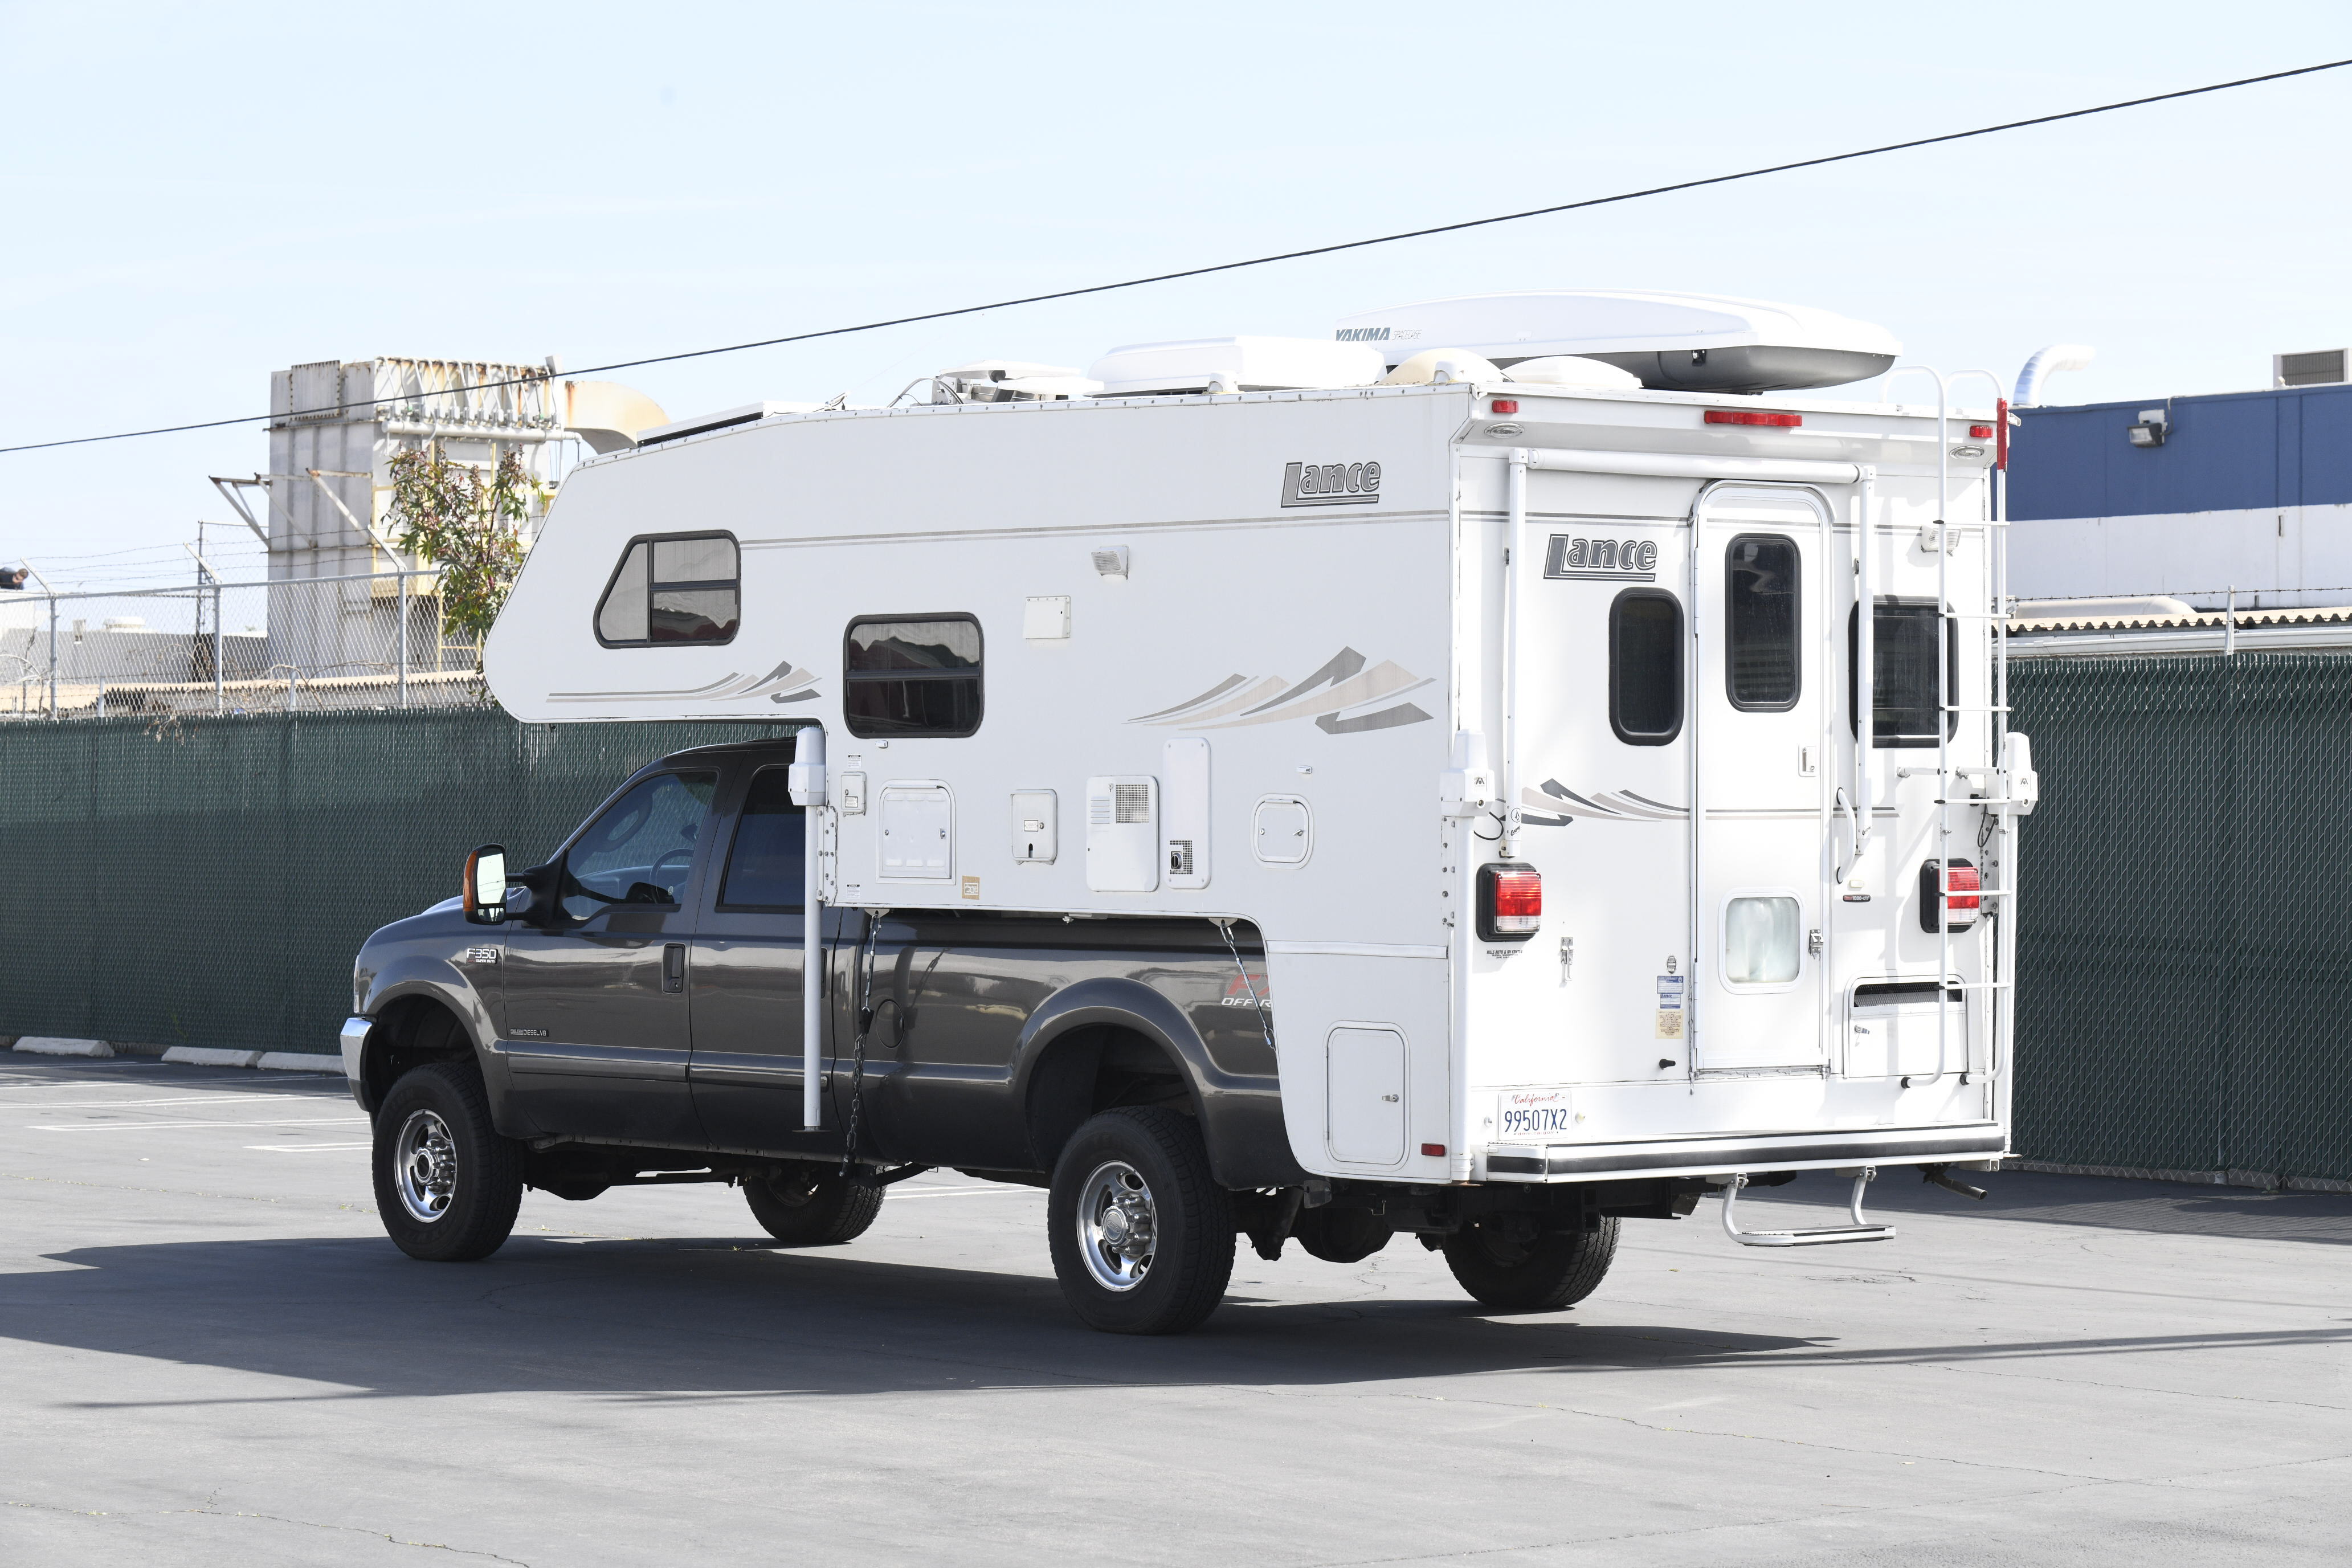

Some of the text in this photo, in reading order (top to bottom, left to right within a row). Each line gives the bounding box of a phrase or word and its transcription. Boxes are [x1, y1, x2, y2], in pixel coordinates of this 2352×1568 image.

[1336, 327, 1391, 342] YAKIMA
[1280, 461, 1381, 508] Lance
[1543, 533, 1657, 582] Lance
[1221, 998, 1254, 1006] OFF
[1514, 1093, 1559, 1106] California
[1505, 1108, 1567, 1133] 99507X2
